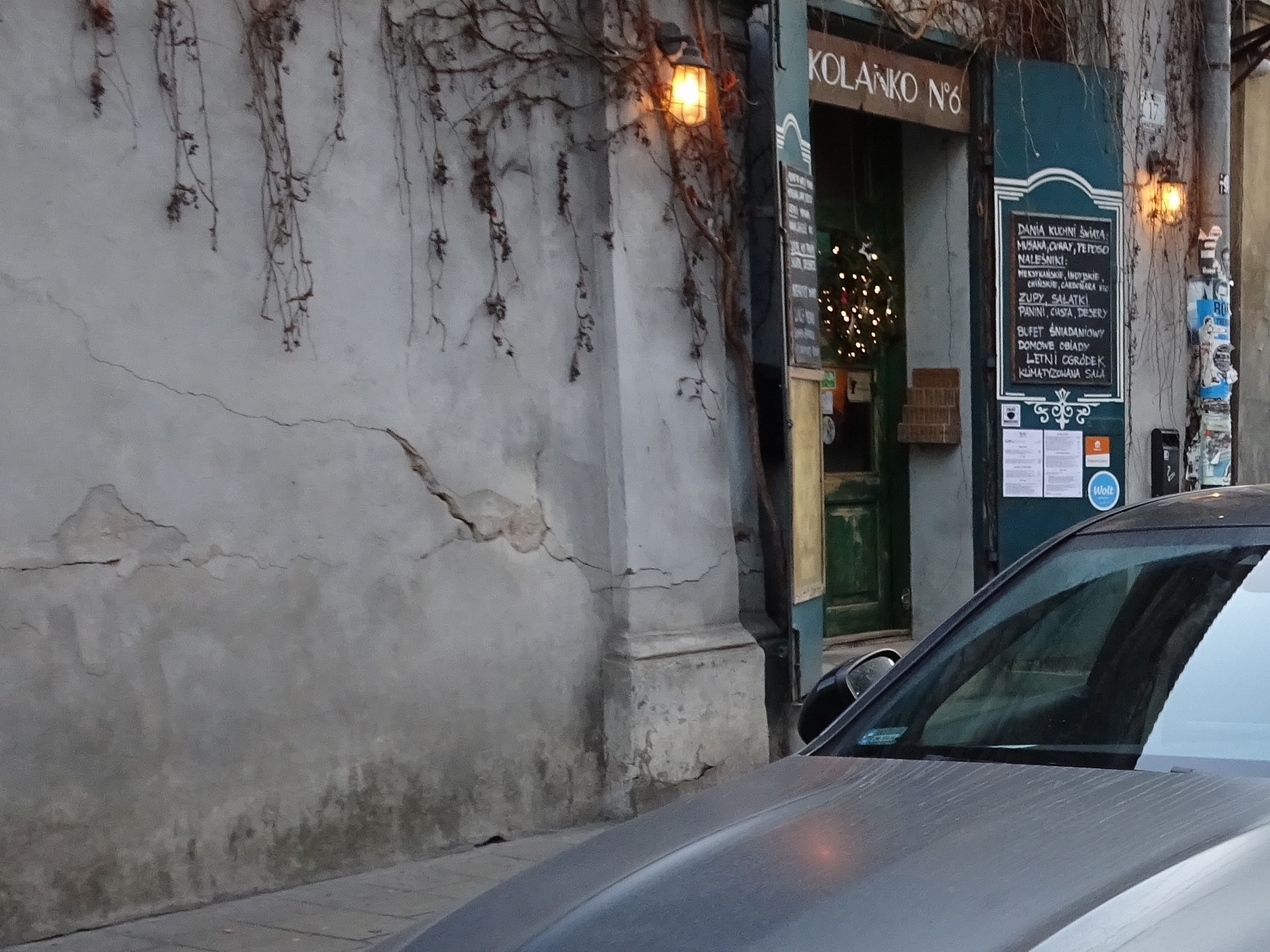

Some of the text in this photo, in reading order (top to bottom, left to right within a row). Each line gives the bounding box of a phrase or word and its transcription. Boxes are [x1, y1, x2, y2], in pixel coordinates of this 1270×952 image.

[1017, 222, 1046, 236] DANIA
[1048, 224, 1077, 238] KUCHNI
[1017, 253, 1068, 266] NALEŚNIKI:
[1077, 308, 1108, 319] DESERY
[1017, 322, 1105, 338] BUFET ŚNIADANIOWY
[1018, 339, 1090, 351] DOMOWE OBIADY
[1026, 351, 1106, 368] LETNI OGRÓDEK
[1084, 368, 1106, 379] SALA
[1093, 484, 1114, 496] Wolt
